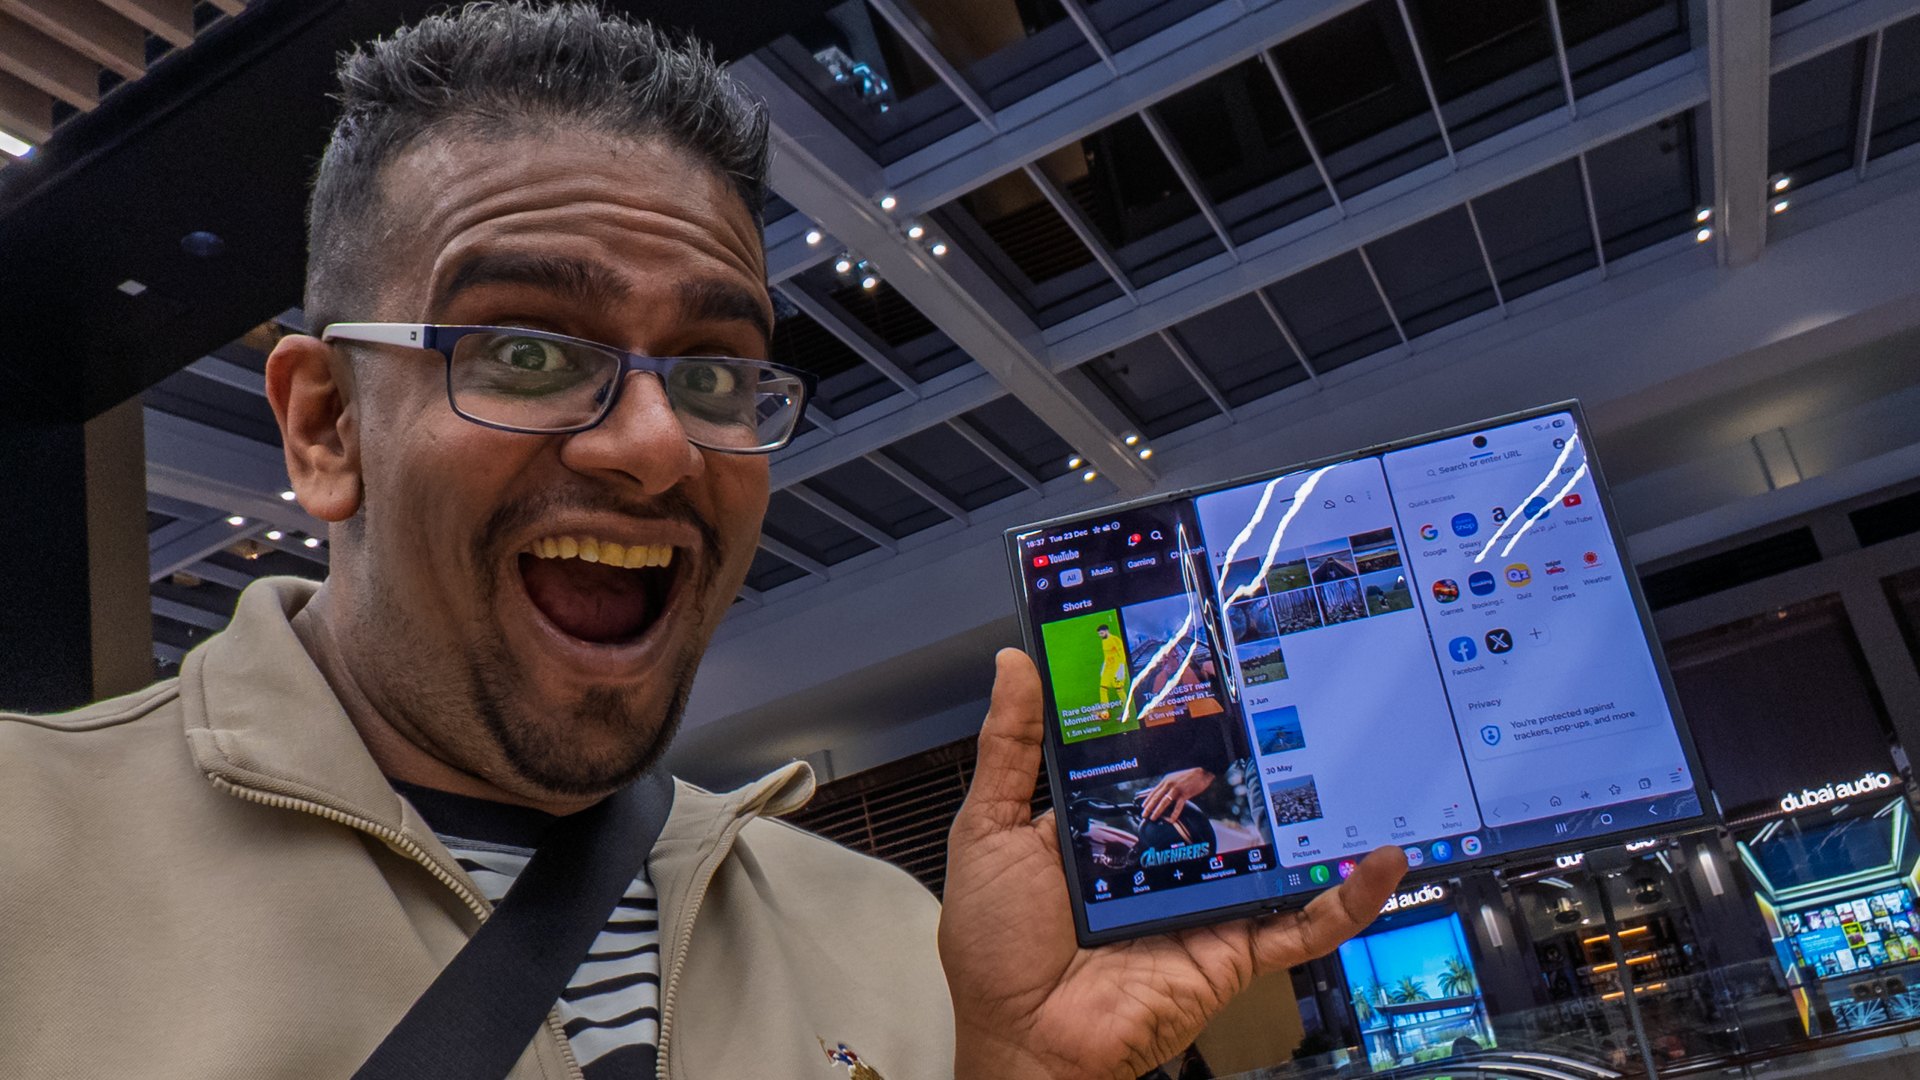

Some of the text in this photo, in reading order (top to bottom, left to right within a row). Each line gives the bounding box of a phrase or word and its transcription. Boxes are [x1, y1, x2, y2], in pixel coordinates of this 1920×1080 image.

[1439, 450, 1522, 474] Search or enter URL
[1408, 494, 1456, 509] Quick access
[1564, 515, 1593, 526] YouTube
[1026, 528, 1089, 548] 18:37 Tue 23 Dec
[1458, 540, 1482, 550] Galaxy
[1048, 549, 1080, 564] YouTube
[1422, 547, 1448, 559] Google
[1066, 574, 1077, 582] All
[1090, 566, 1114, 577] Music
[1127, 557, 1156, 569] Gaming
[1582, 574, 1612, 586] Weather
[1552, 584, 1569, 592] Free
[1516, 592, 1532, 600] Quiz
[1552, 592, 1576, 602] Games
[1062, 600, 1092, 612] Shorts
[1440, 608, 1464, 617] Games
[1452, 664, 1486, 676] Facebook
[1194, 682, 1212, 691] new
[1062, 700, 1123, 718] Rare Goalkeeper
[1468, 698, 1502, 711] Privacy
[1166, 708, 1184, 718] views
[1510, 702, 1616, 730] You're protected against
[1514, 726, 1554, 741] trackers,
[1554, 718, 1594, 734] pop-ups,
[1594, 714, 1611, 724] and
[1068, 757, 1139, 781] Recommended
[1266, 764, 1293, 774] 30 May
[1780, 772, 1891, 813] dubai audio
[1441, 820, 1462, 831] Menu
[1390, 828, 1416, 840] Stories
[1342, 838, 1368, 850] Albums
[1140, 842, 1210, 868] AVENGERS
[1292, 848, 1321, 860] Pictures
[1398, 884, 1444, 908] audio
